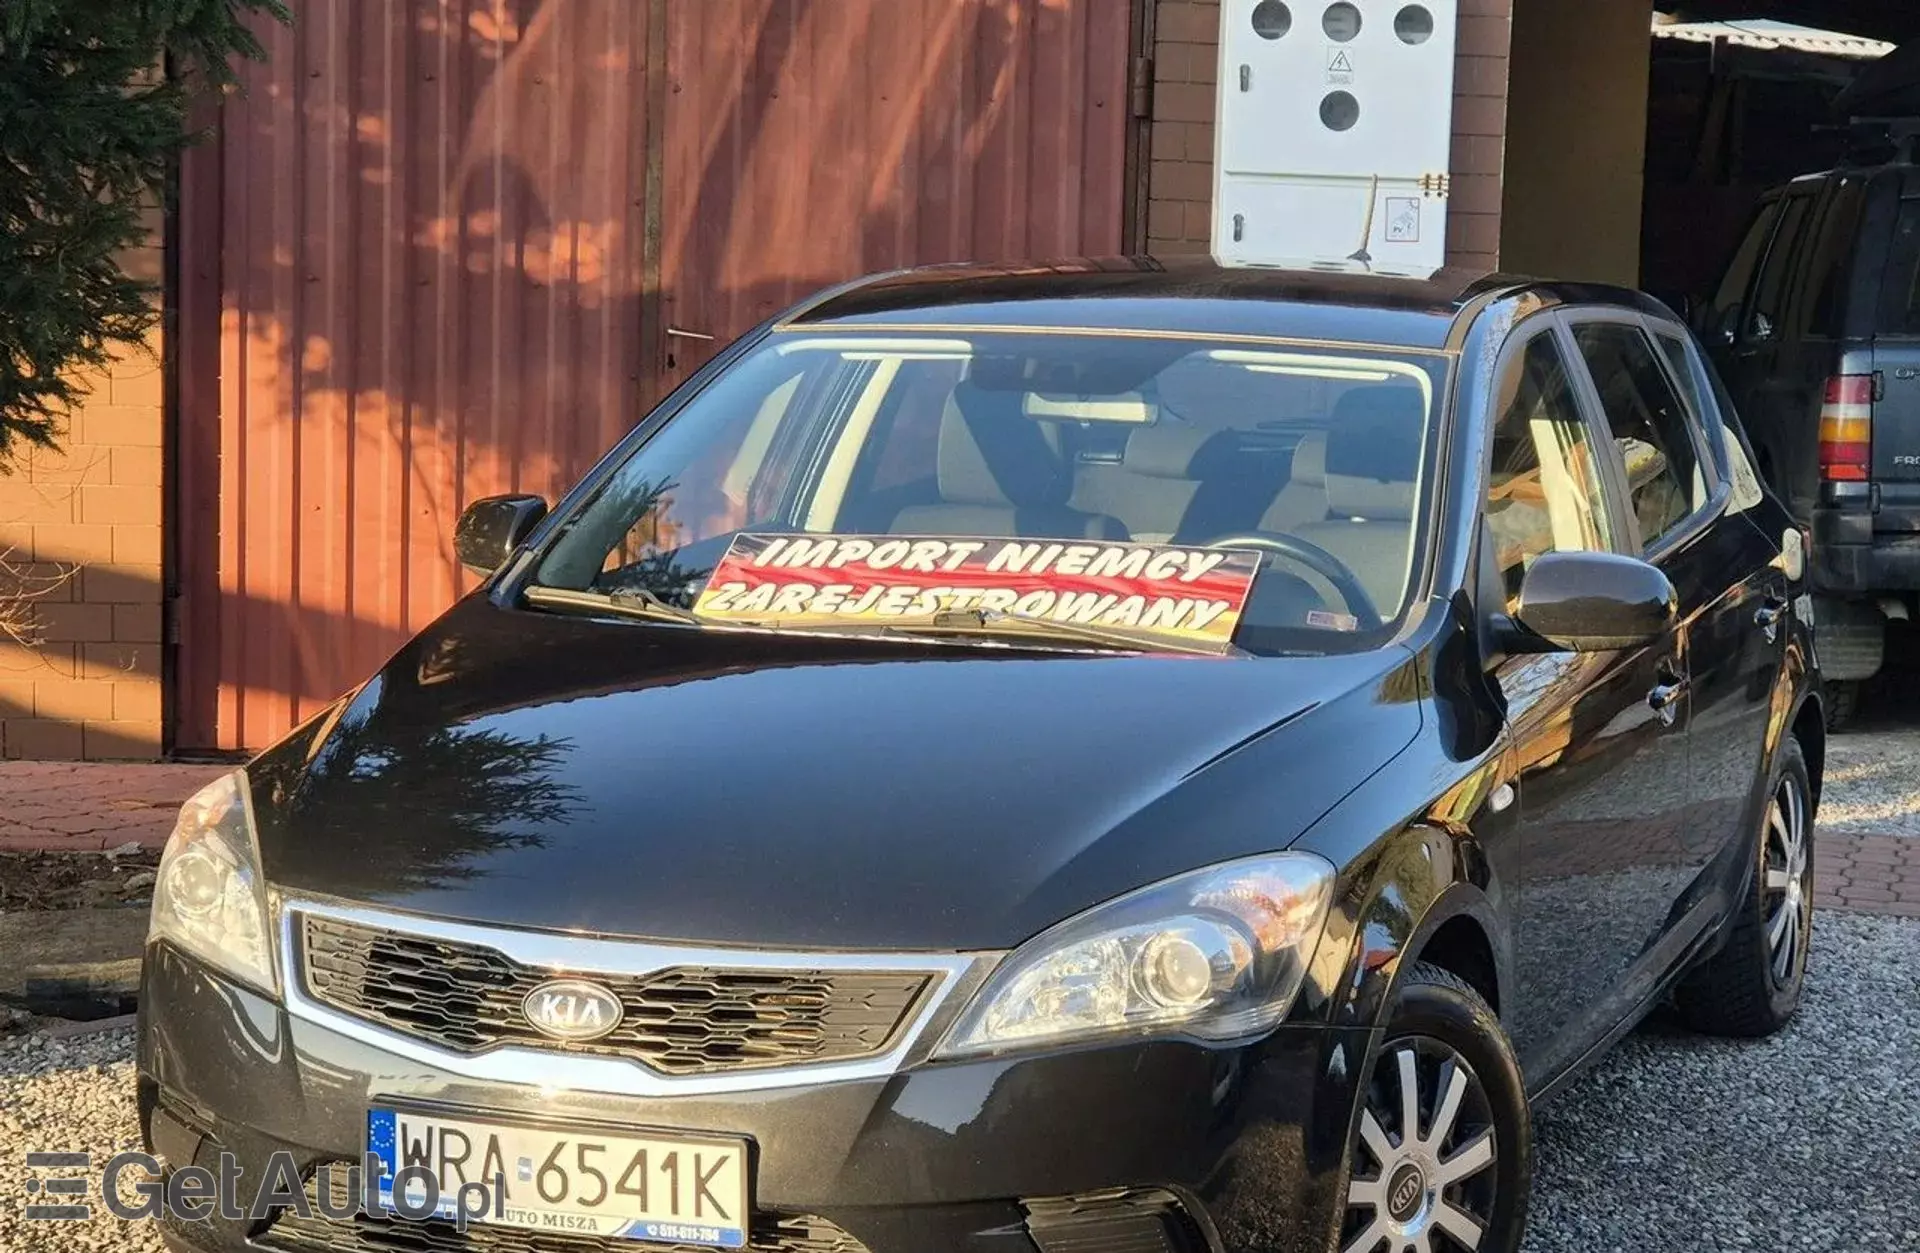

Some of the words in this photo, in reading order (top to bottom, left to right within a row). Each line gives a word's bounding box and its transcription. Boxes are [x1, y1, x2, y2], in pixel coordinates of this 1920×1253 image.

[753, 538, 985, 573] IMPORT
[985, 542, 1225, 583] NIEMCY
[706, 582, 1231, 632] ZAREJESTROWANY
[541, 994, 602, 1028] KIA
[401, 1122, 511, 1201] WRA
[536, 1140, 731, 1221] 6541K
[1394, 1178, 1418, 1209] KIA
[494, 1208, 538, 1225] UTO
[543, 1213, 599, 1231] MISZA
